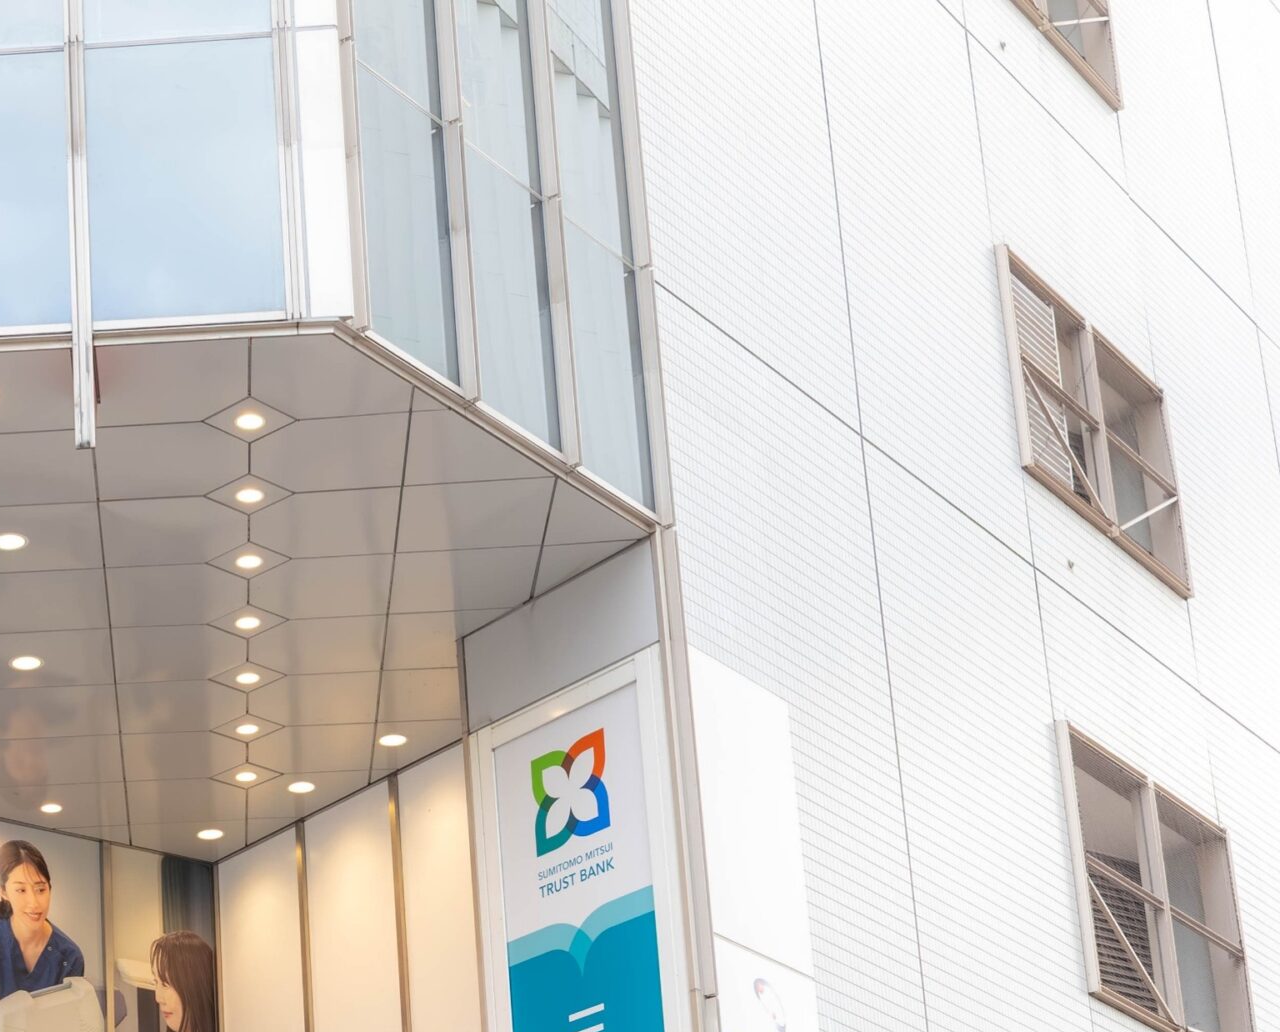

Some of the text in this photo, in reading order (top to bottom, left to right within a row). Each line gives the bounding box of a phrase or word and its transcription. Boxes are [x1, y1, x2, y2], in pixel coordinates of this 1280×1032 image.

[537, 842, 613, 881] SUMITOMO MITSUI
[539, 857, 615, 899] TRUST BANK
